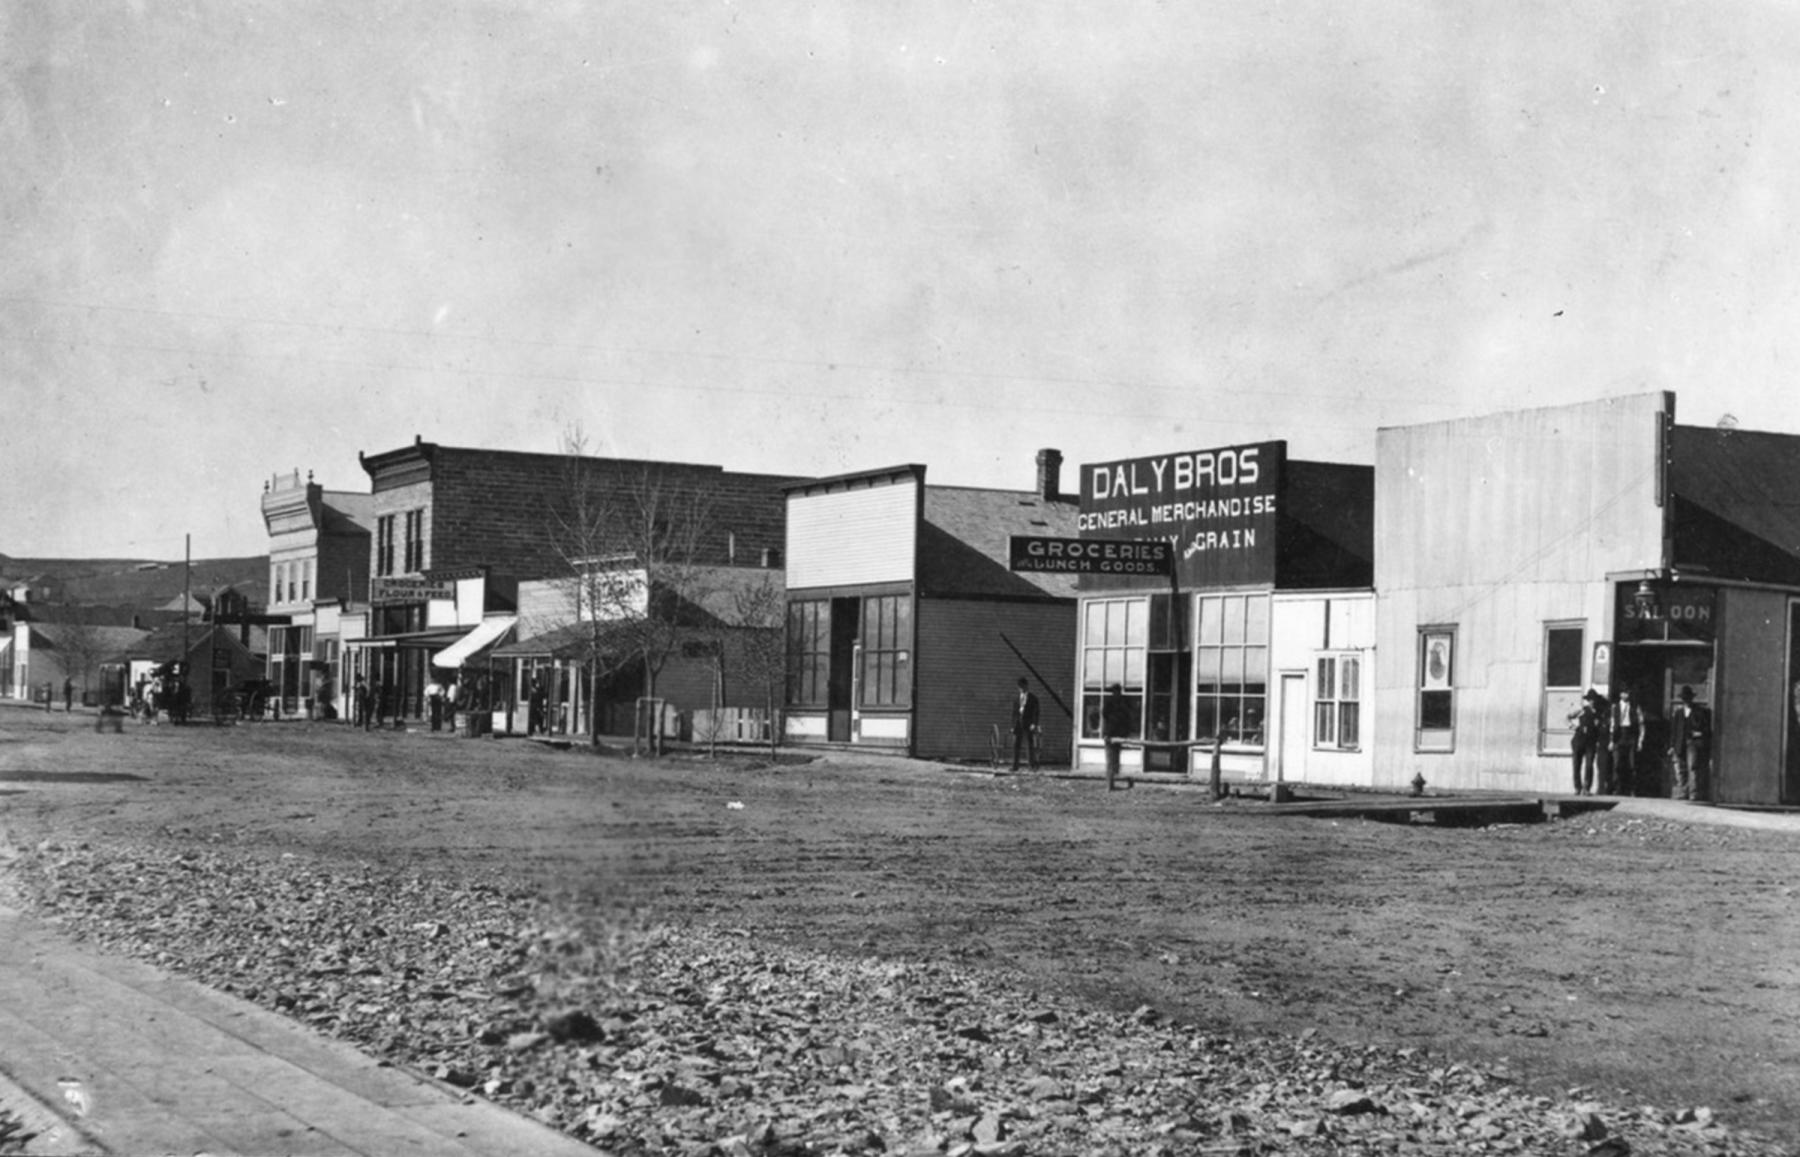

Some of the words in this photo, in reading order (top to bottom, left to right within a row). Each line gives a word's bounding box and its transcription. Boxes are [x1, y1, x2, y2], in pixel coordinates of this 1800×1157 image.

[1092, 459, 1168, 499] DALY
[1174, 448, 1260, 490] BROS
[1078, 509, 1149, 531] GENERAL
[1151, 494, 1276, 523] MERCHANDISE
[1195, 528, 1256, 550] GRAIN
[1027, 541, 1165, 560] GROCERIES
[1035, 559, 1091, 570] LUNCH
[1624, 604, 1710, 619] SALOON
